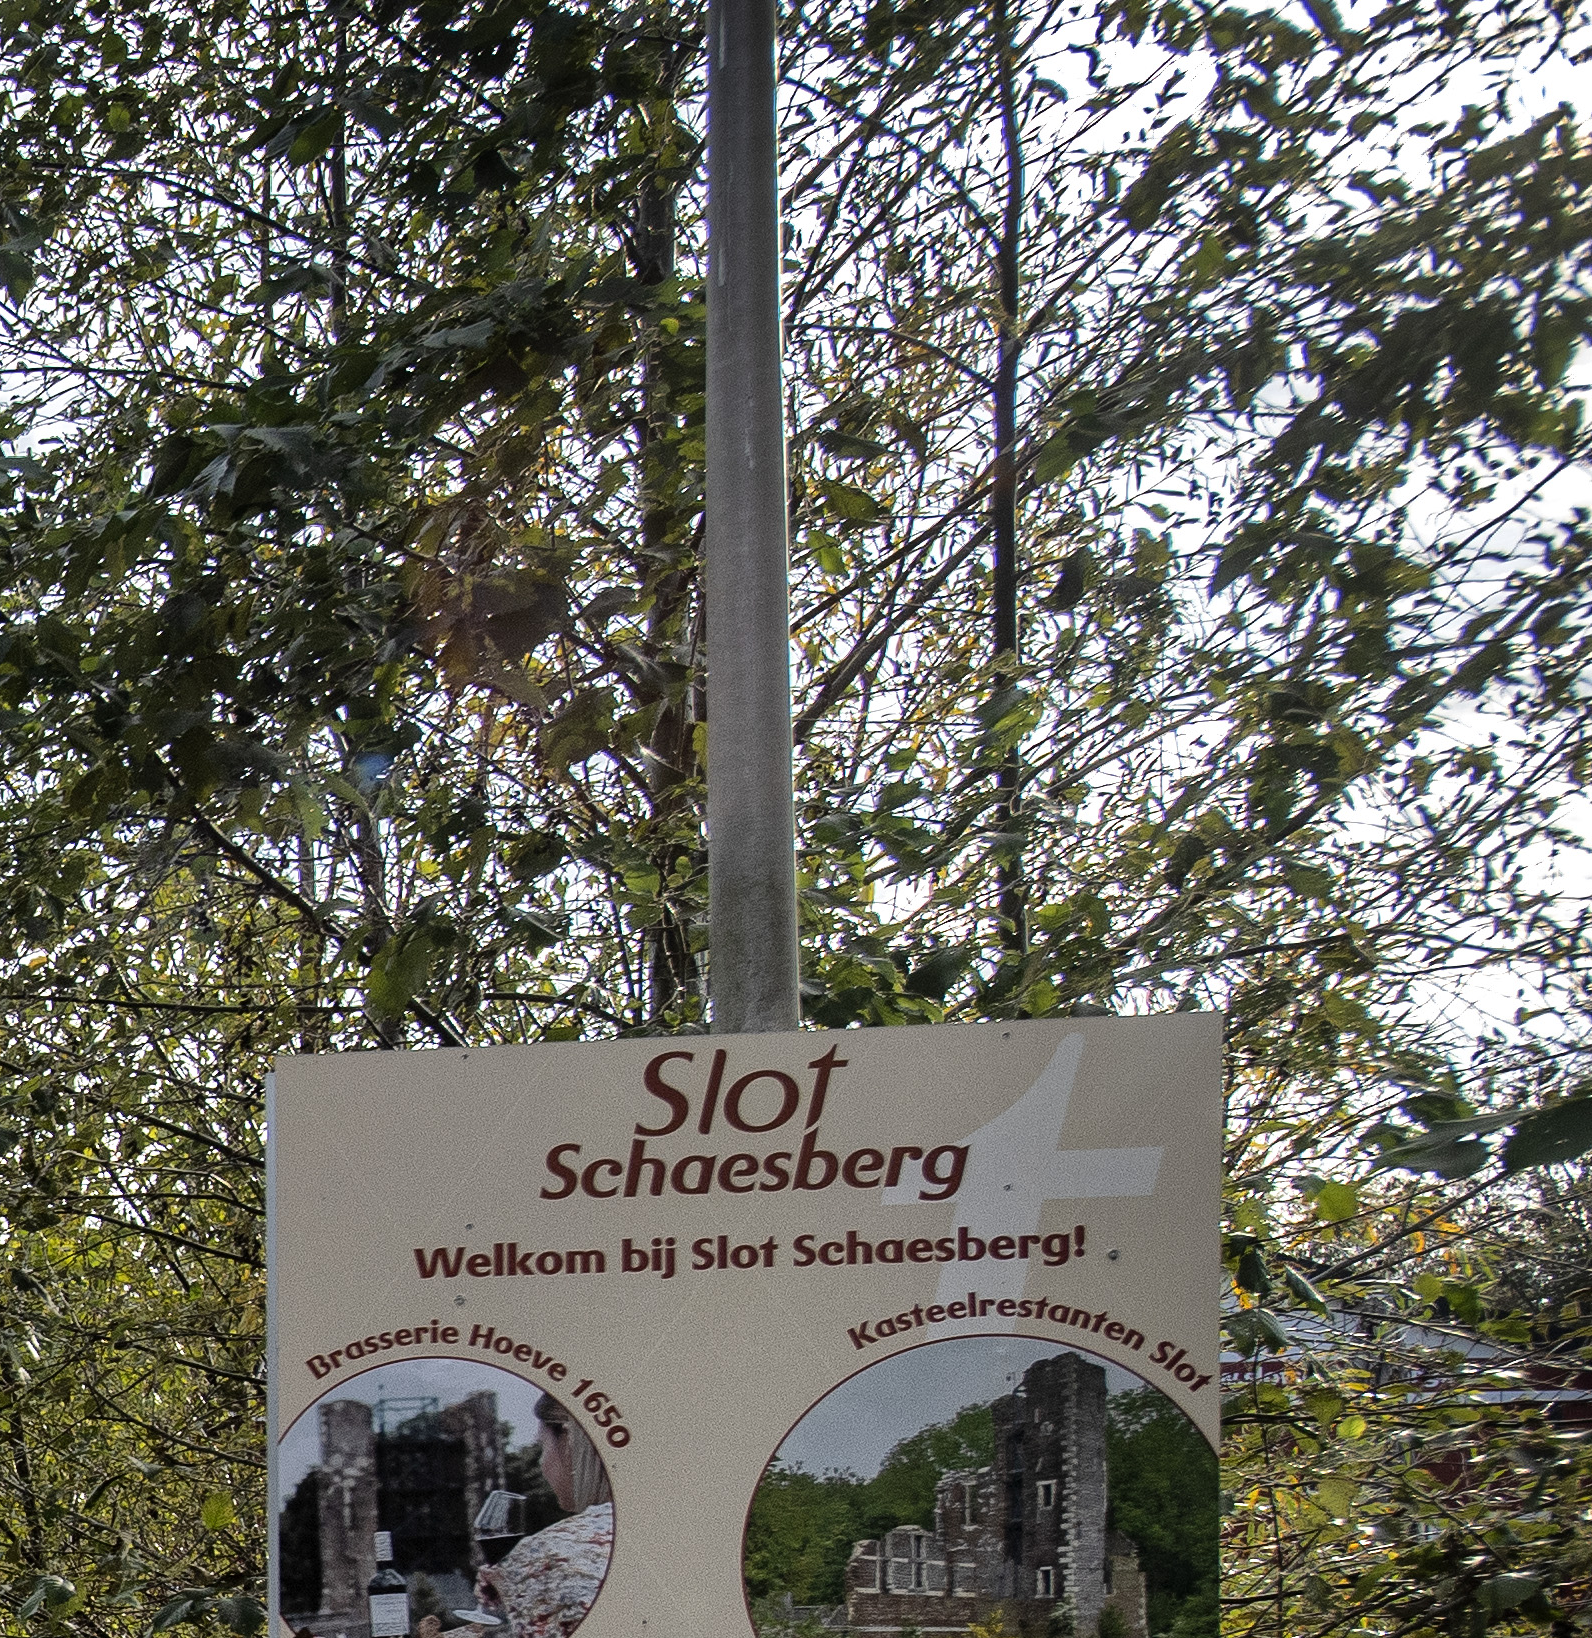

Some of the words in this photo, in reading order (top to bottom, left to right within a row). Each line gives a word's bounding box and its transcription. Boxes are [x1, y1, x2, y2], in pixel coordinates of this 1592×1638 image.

[633, 1043, 850, 1137] Slot
[539, 1127, 973, 1201] Schaesberg
[414, 1242, 606, 1279] Welkom
[621, 1237, 676, 1279] bij
[691, 1235, 778, 1270] Slot
[792, 1225, 1086, 1266] Schaesberg!
[305, 1319, 460, 1380] Brasserie
[468, 1323, 567, 1382] Hoeve
[571, 1378, 631, 1449] 1650
[846, 1292, 1146, 1352] Kasteelrestanten
[1148, 1340, 1214, 1392] Slot
